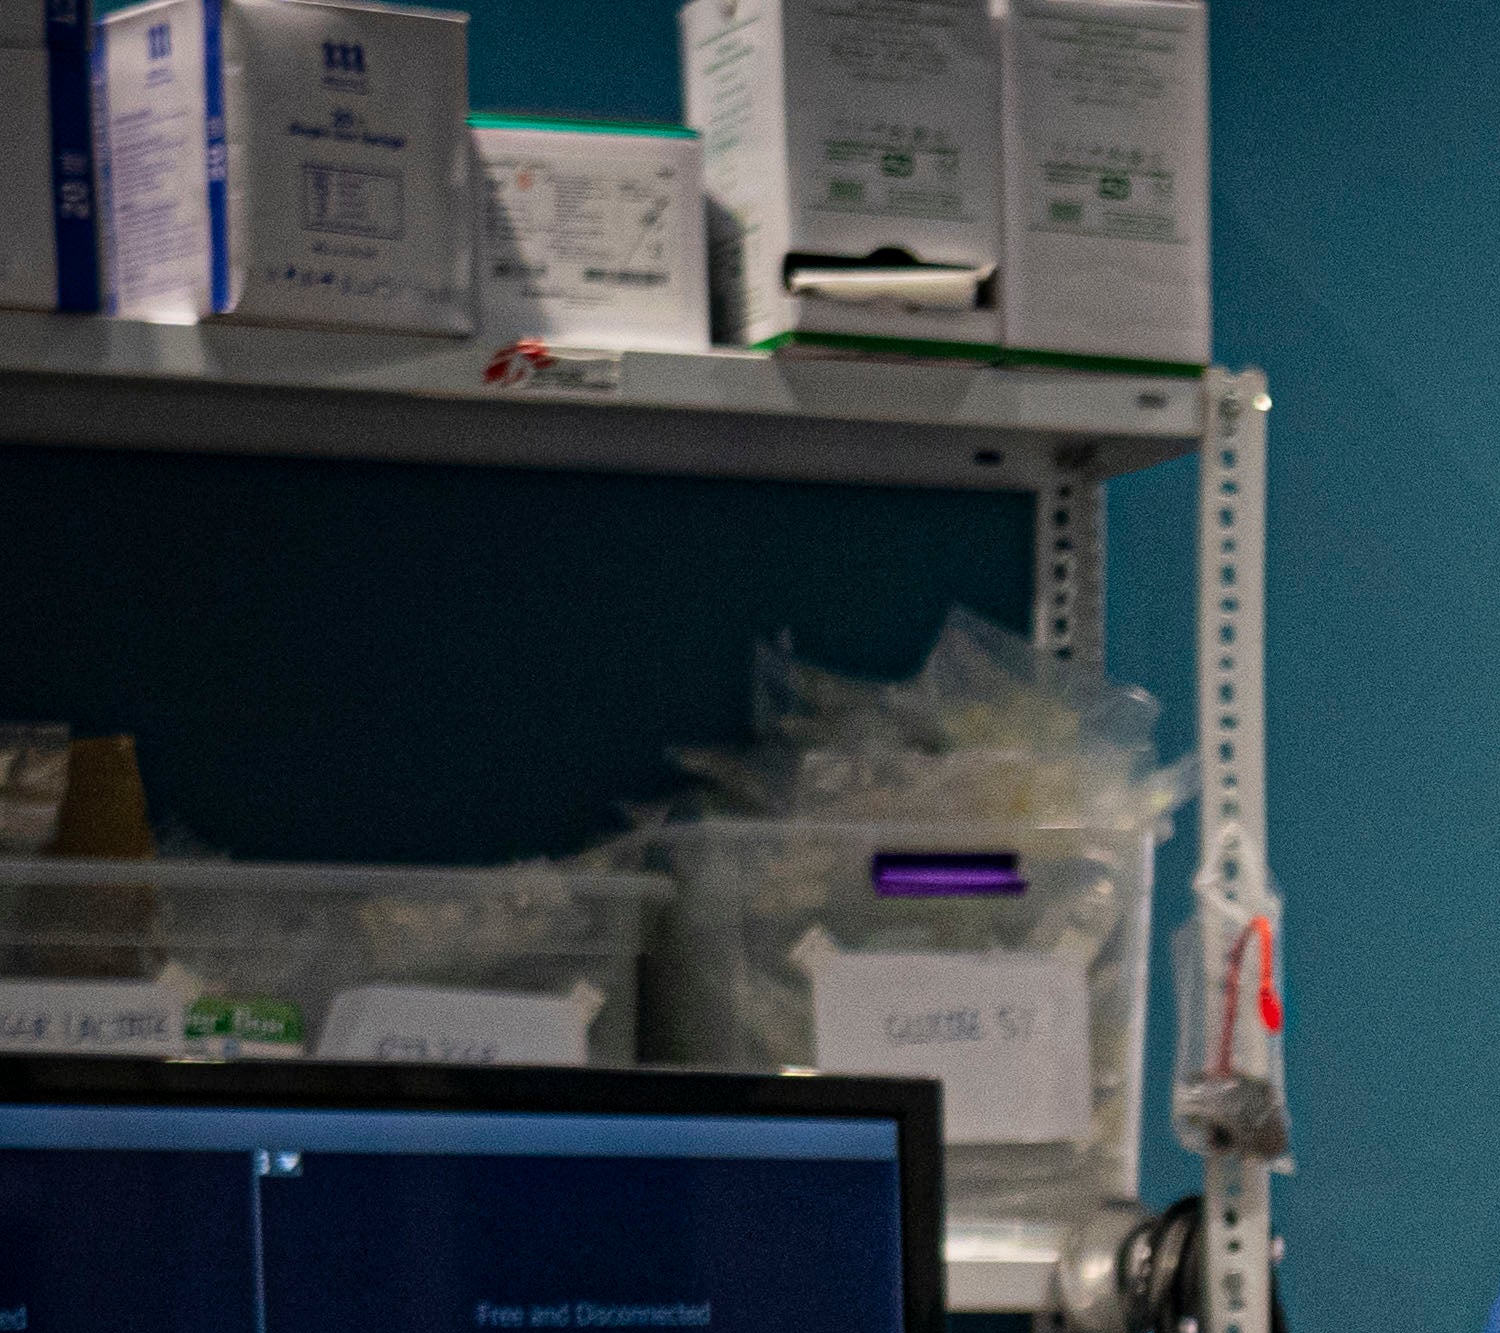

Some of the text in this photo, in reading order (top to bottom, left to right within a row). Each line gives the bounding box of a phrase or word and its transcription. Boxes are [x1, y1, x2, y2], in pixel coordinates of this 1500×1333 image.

[475, 1301, 712, 1328] Free and Disconnected
